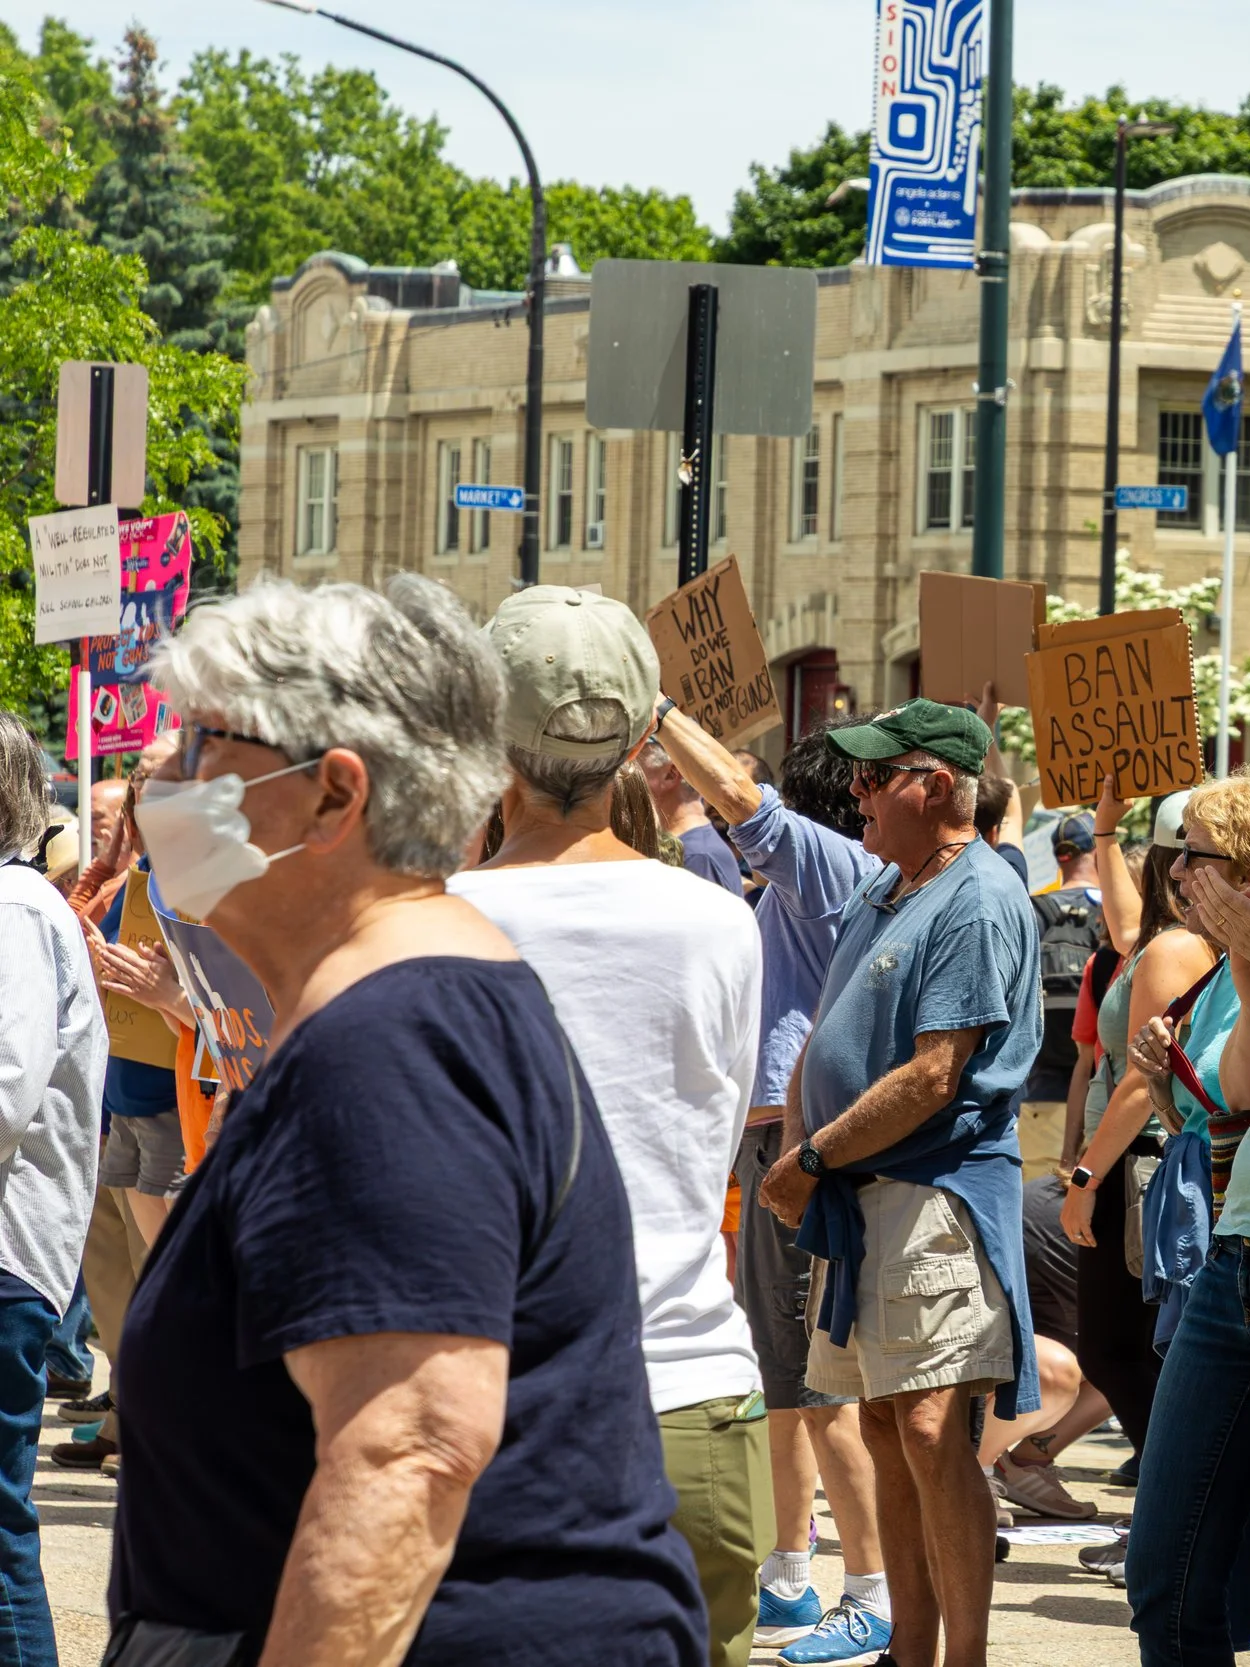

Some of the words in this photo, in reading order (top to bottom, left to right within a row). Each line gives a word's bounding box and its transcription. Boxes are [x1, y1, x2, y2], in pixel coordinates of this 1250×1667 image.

[460, 489, 499, 504] MARKET
[93, 553, 108, 568] NOT
[671, 575, 724, 645] WHY
[97, 650, 118, 673] NOT
[690, 643, 708, 667] DO
[706, 627, 731, 653] WE
[693, 647, 736, 700] BAN
[1064, 638, 1154, 707] BAN
[713, 685, 735, 715] NOT
[1050, 694, 1193, 761] ASSAULT
[1047, 740, 1197, 803] WEAPONS
